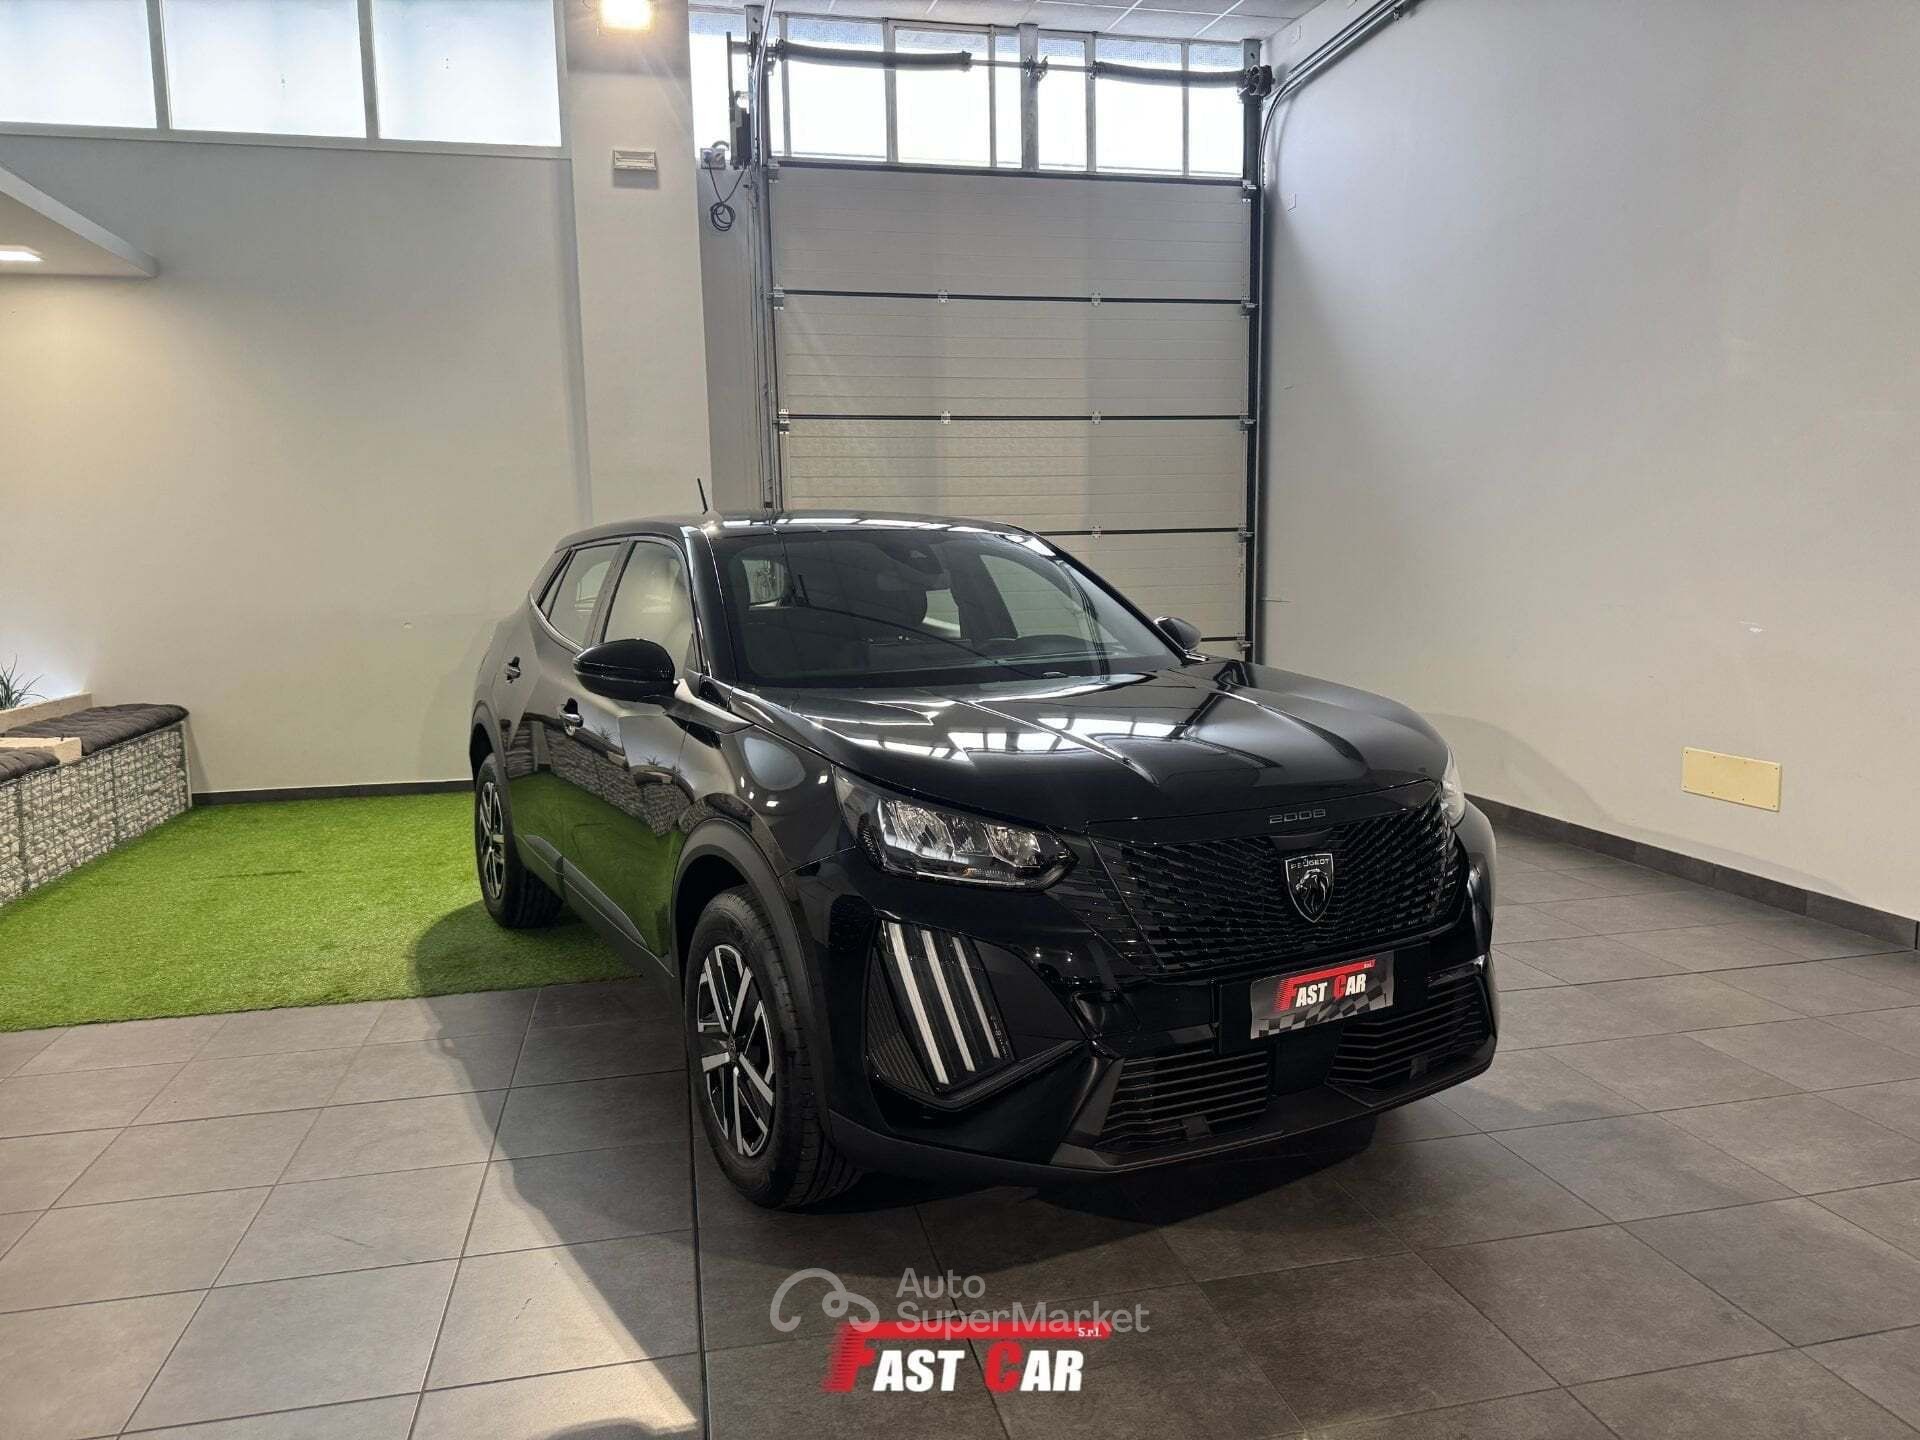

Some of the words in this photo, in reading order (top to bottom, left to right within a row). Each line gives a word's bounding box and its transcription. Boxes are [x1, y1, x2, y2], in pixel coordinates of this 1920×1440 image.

[1268, 808, 1327, 825] 2008
[1290, 857, 1330, 869] PEUGEOT
[1273, 972, 1328, 1013] FAST
[1332, 973, 1367, 1003] CAR
